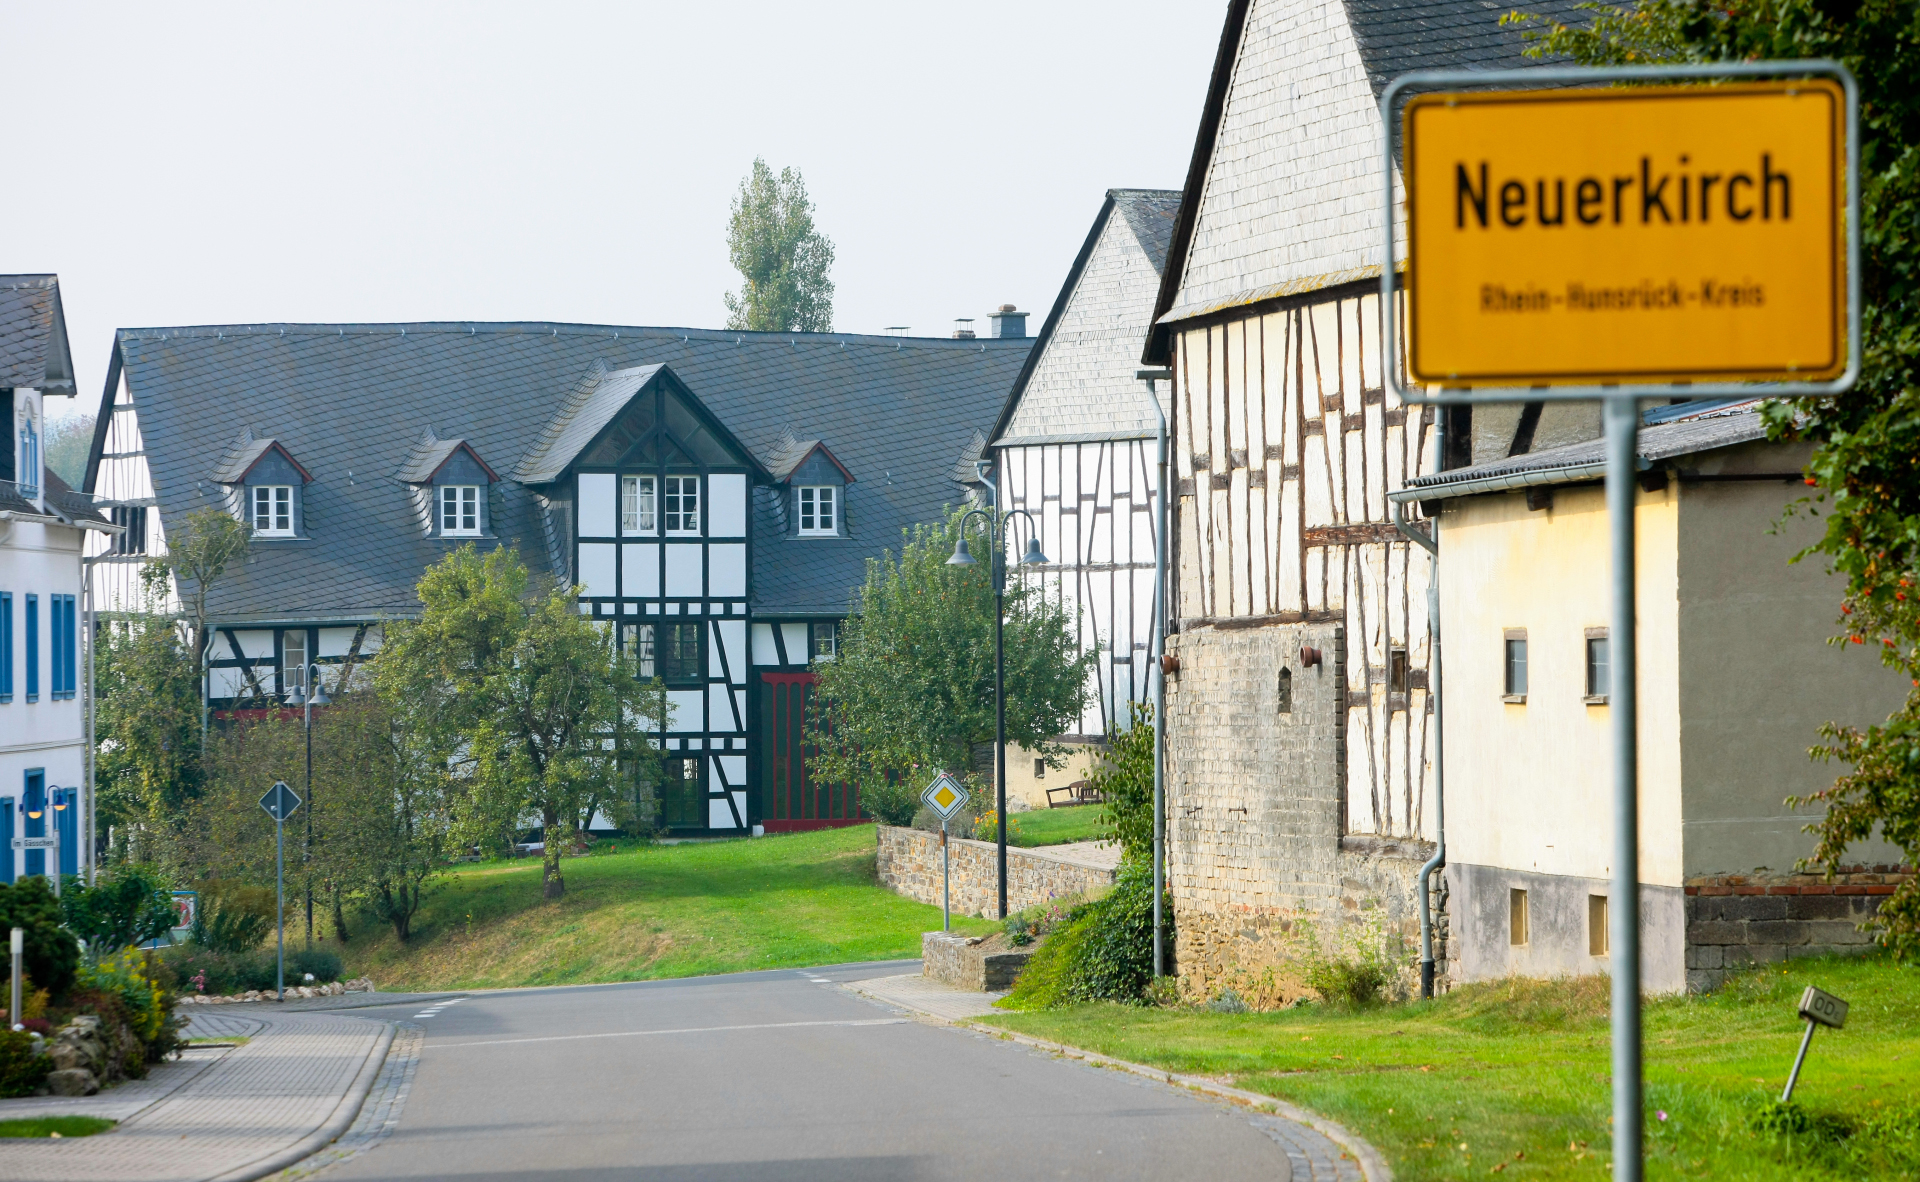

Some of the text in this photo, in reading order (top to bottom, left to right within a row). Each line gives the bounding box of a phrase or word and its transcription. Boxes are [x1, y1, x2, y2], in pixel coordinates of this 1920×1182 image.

[1455, 152, 1792, 230] Neuerkirch
[1480, 277, 1765, 313] Rhein-Hunsrück-Kreis
[13, 839, 21, 848] Im
